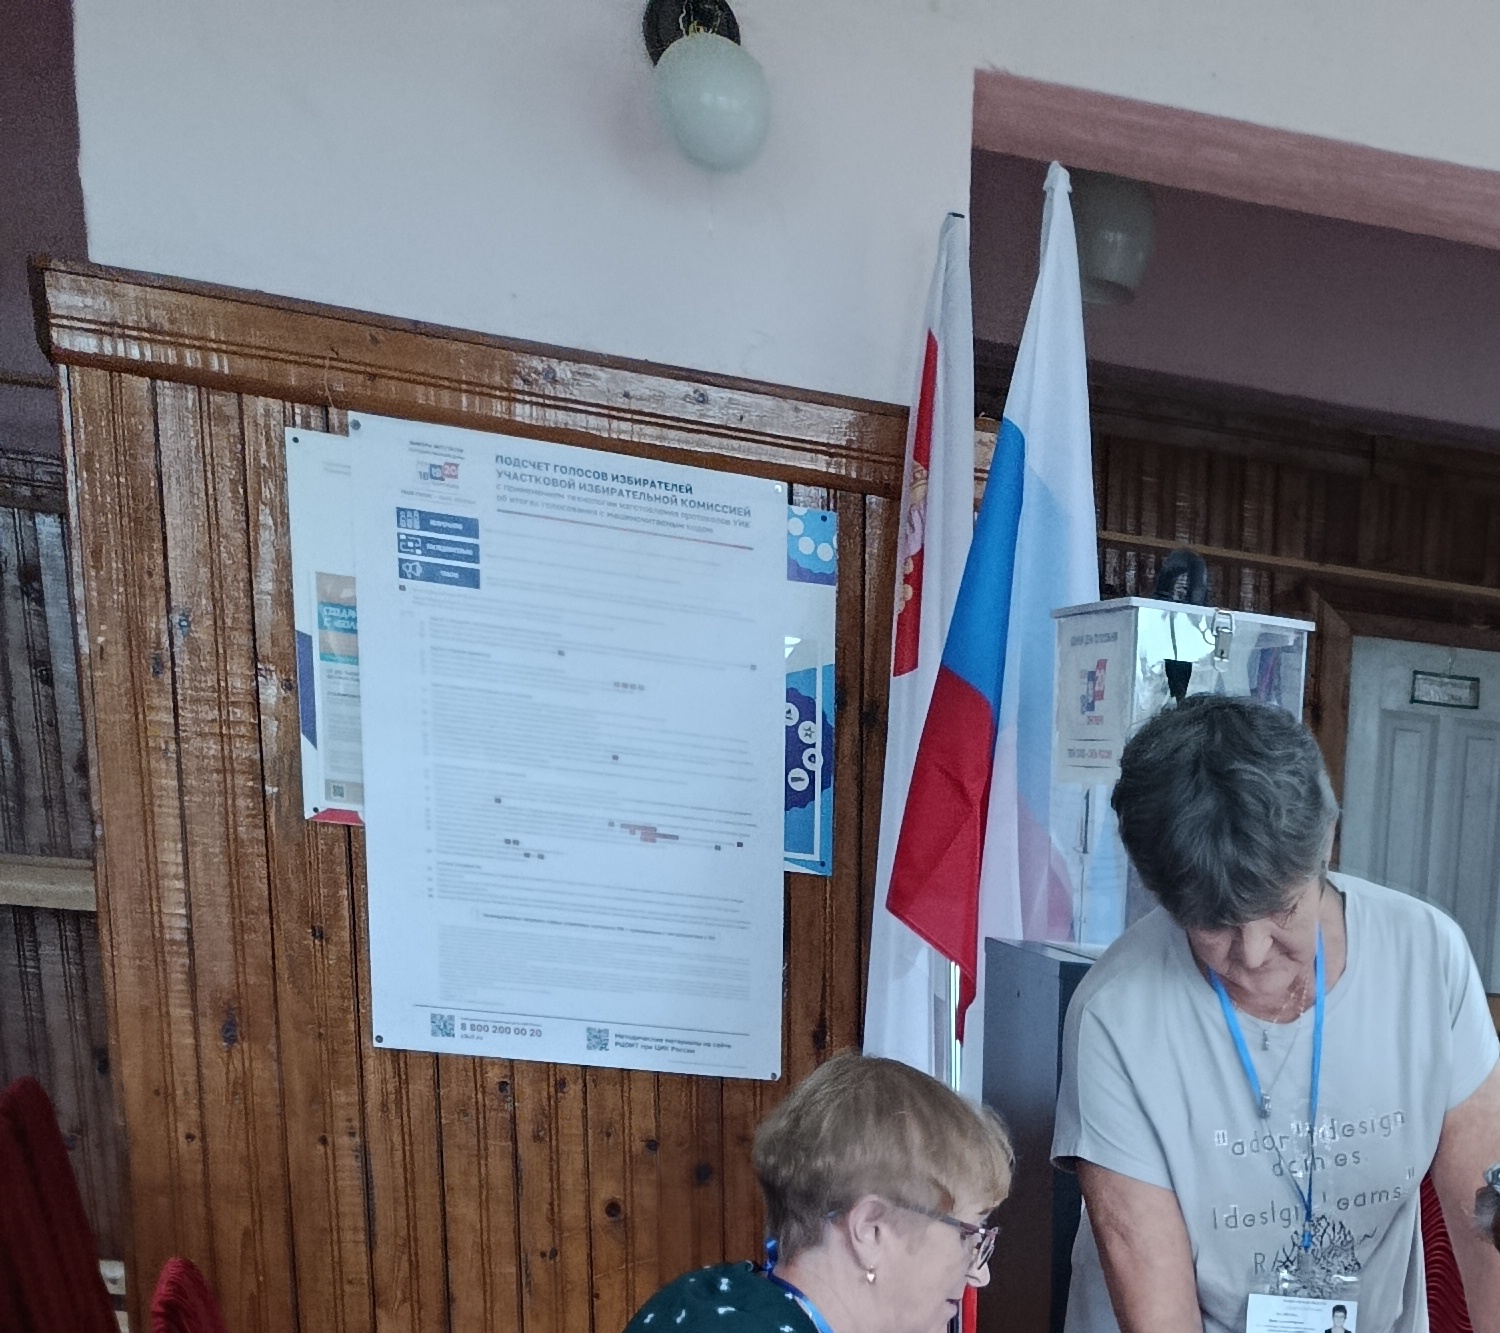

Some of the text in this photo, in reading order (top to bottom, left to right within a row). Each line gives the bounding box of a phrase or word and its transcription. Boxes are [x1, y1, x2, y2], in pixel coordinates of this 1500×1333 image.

[495, 454, 693, 494] ПОДСЧЕТ ГОЛОСОВ ИЗБИРАТЕЛЕЙ
[496, 469, 752, 518] УЧАСТКОВОЙ ИЗБИРАТЕЛЬНОЙ КОМИССИЕЙ
[470, 1024, 490, 1033] 800
[492, 1025, 511, 1035] 200
[513, 1027, 527, 1036] 00
[529, 1028, 542, 1037] 20
